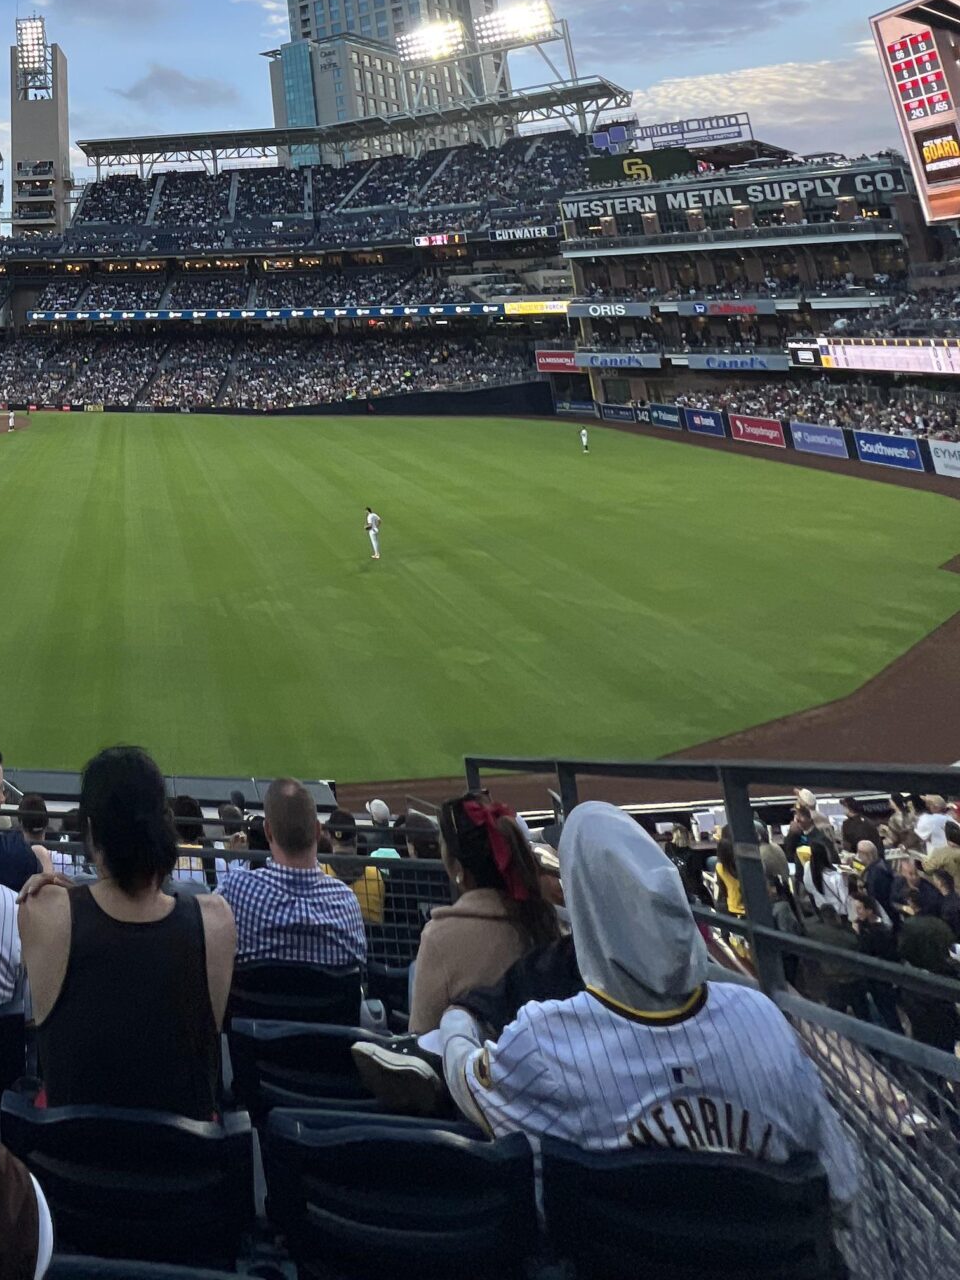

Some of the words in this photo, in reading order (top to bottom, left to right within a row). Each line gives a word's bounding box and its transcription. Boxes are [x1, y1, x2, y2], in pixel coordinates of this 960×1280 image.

[918, 42, 926, 52] 13
[926, 62, 932, 71] 0
[903, 70, 908, 78] 6
[932, 83, 938, 92] 3
[922, 140, 960, 163] BOARD
[562, 195, 658, 219] WESTERN
[666, 188, 742, 210] METAL
[746, 176, 842, 203] SUPPLY
[854, 172, 904, 193] CO.
[496, 226, 548, 240] CUTWATER
[588, 305, 626, 316] ORIS
[744, 424, 780, 439] Snapdragon
[860, 440, 910, 460] Southwest
